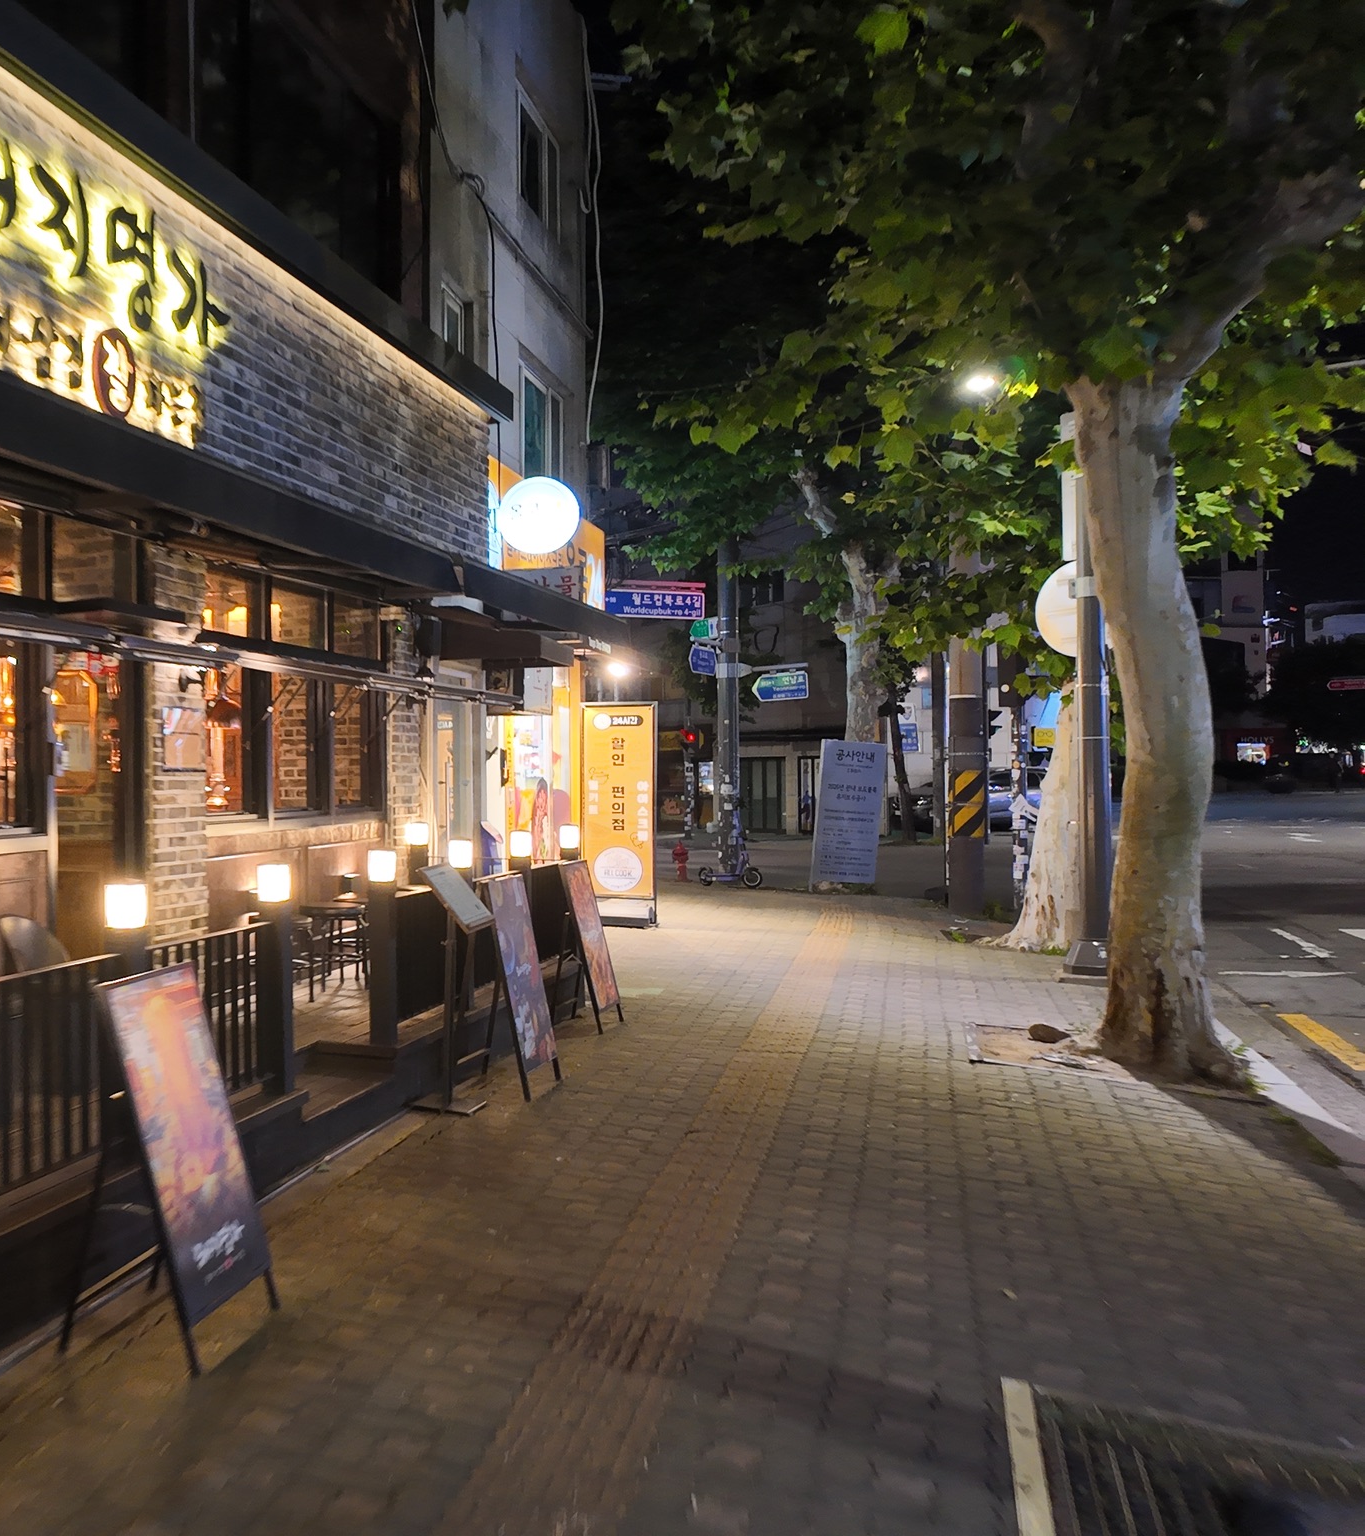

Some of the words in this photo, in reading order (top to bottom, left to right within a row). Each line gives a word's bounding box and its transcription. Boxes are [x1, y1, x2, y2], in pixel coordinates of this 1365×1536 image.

[631, 593, 701, 608] 월드컵북로4길
[623, 605, 683, 616] Worldcupbuk-ro
[684, 609, 701, 617] 4-gil
[612, 716, 639, 726] 24시간
[1240, 736, 1275, 744] HOLLYS
[611, 737, 625, 767] 할인
[835, 749, 876, 763] 공사안내
[611, 786, 625, 831] 편의점
